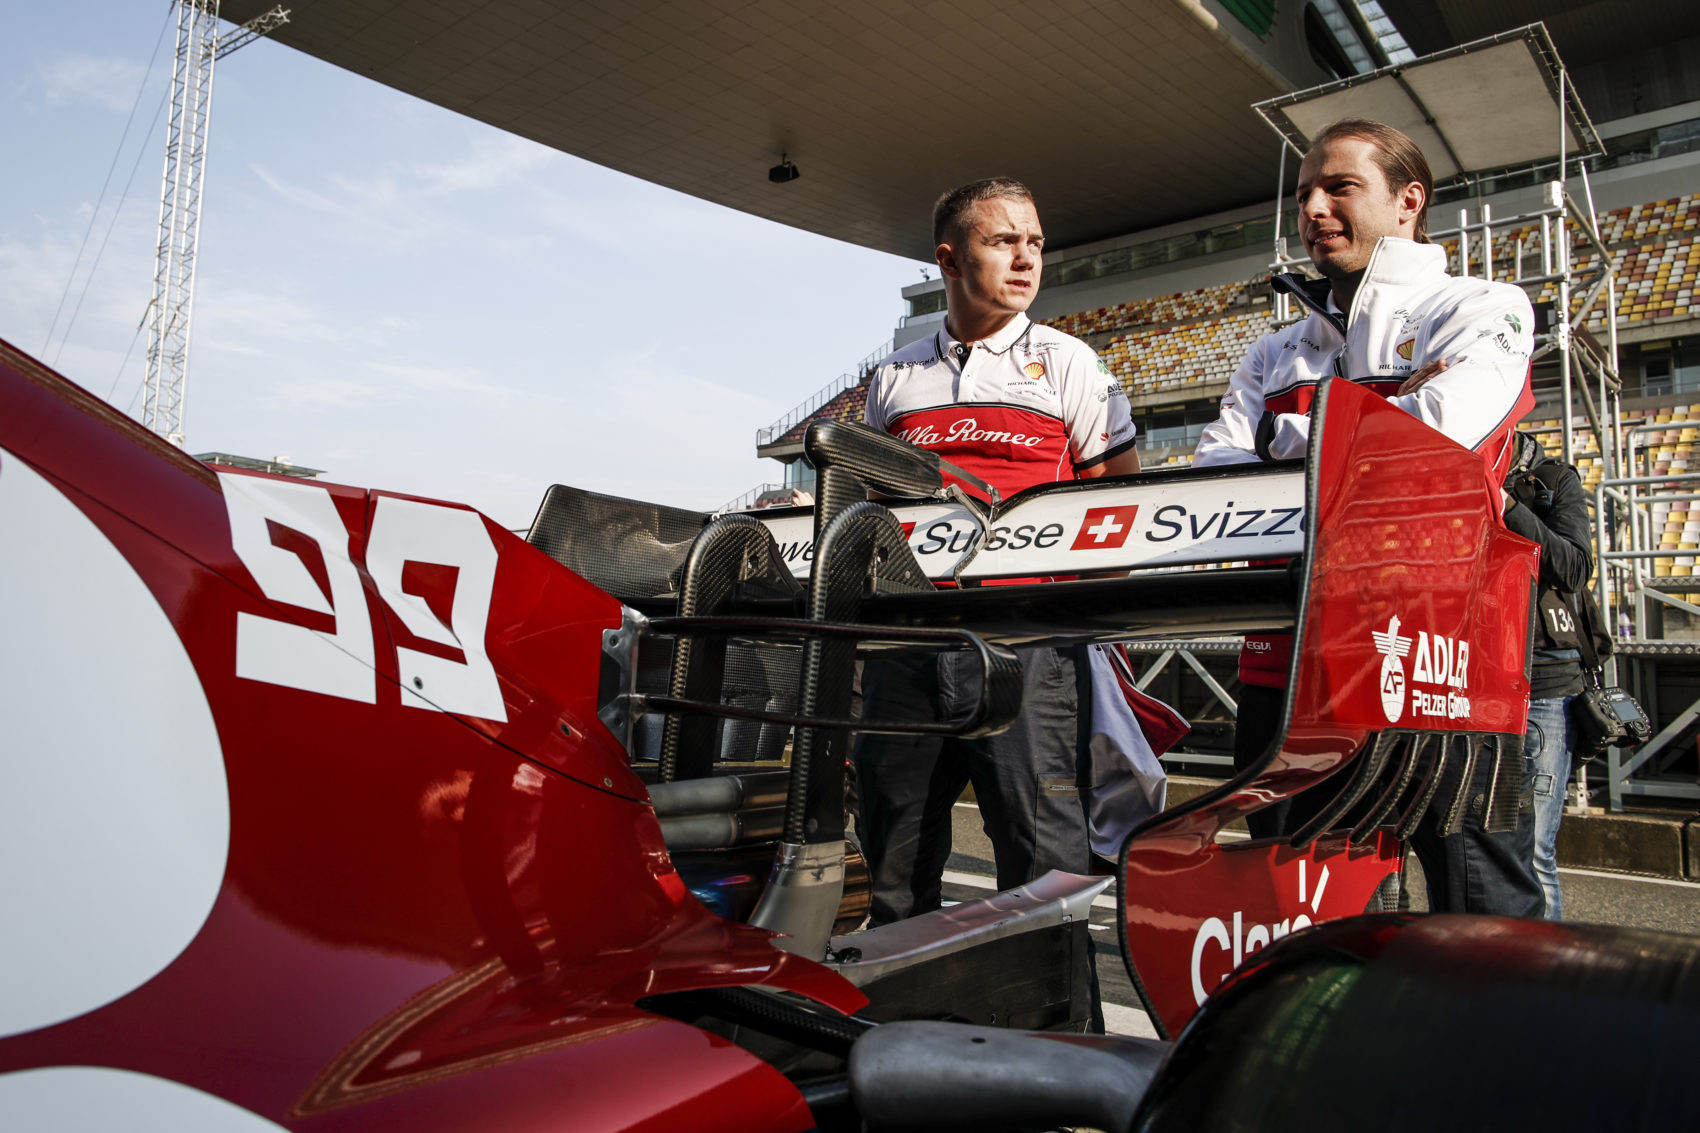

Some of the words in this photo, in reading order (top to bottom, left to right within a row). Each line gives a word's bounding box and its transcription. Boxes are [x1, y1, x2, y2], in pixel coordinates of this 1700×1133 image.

[896, 425, 944, 446] Alfa
[944, 418, 1044, 447] Romeo
[917, 521, 1064, 555] Susse
[1145, 501, 1306, 542] Svizz
[215, 471, 508, 723] 99
[1412, 630, 1469, 689] ADLER
[1412, 689, 1447, 717] PELZER
[1447, 691, 1471, 719] GROUP
[1191, 911, 1313, 1008] Cla
